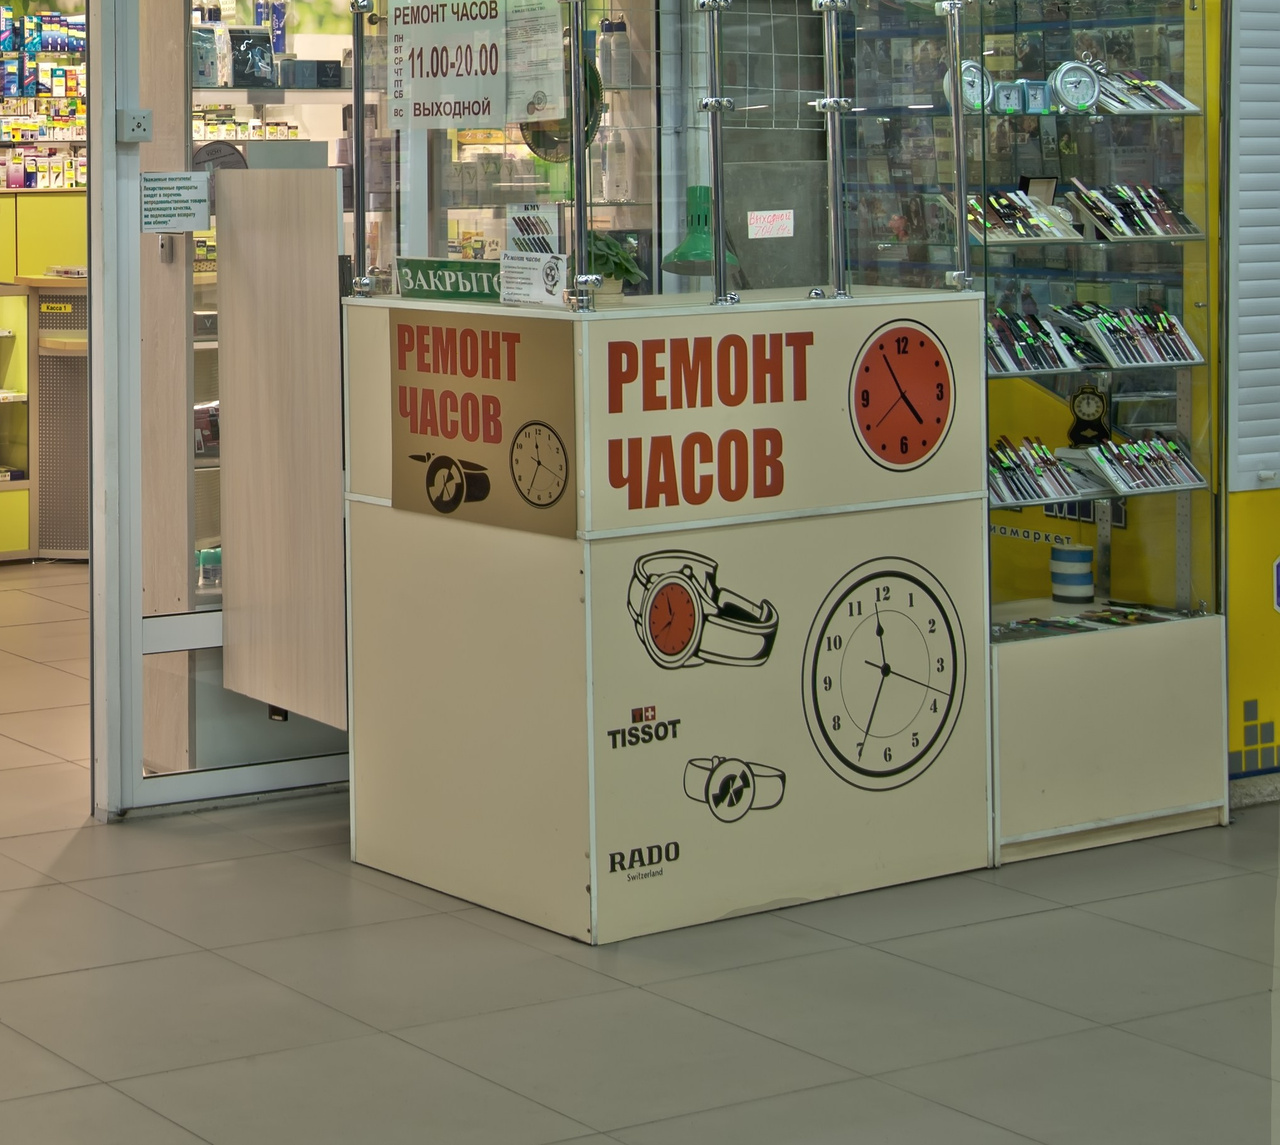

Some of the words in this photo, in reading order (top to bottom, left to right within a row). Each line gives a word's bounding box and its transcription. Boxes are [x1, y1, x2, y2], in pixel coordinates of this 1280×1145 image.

[394, 3, 447, 25] РЕМОНТ
[451, 0, 498, 22] ЧАСОВ
[394, 34, 403, 42] ПН
[394, 46, 403, 54] ВТ
[394, 57, 403, 66] СР
[394, 68, 403, 76] ЧТ
[408, 43, 498, 78] 11.00-20.00
[394, 79, 403, 88] ПТ
[394, 90, 403, 99] СБ
[394, 108, 404, 117] ВС
[413, 97, 491, 118] ВЫХОДНОЙ
[397, 323, 520, 382] РЕМОНТ
[895, 336, 909, 355] 12
[607, 331, 814, 414] РЕМОНТ
[861, 389, 870, 408] 9
[936, 382, 944, 402] 3
[398, 385, 503, 444] ЧАСОВ
[900, 435, 908, 454] 6
[607, 427, 785, 511] ЧАСОВ
[848, 601, 862, 617] 11
[875, 586, 891, 602] 12
[908, 593, 914, 607] 1
[826, 635, 842, 651] 10
[928, 618, 936, 633] 2
[823, 676, 832, 691] 9
[937, 657, 945, 672] 3
[832, 715, 841, 731] 8
[930, 698, 938, 713] 4
[607, 719, 681, 749] TISSOT
[856, 742, 864, 758] 7
[883, 747, 892, 762] 6
[911, 732, 920, 747] 5
[608, 841, 680, 873] RADO
[627, 867, 663, 882] Switzerland
